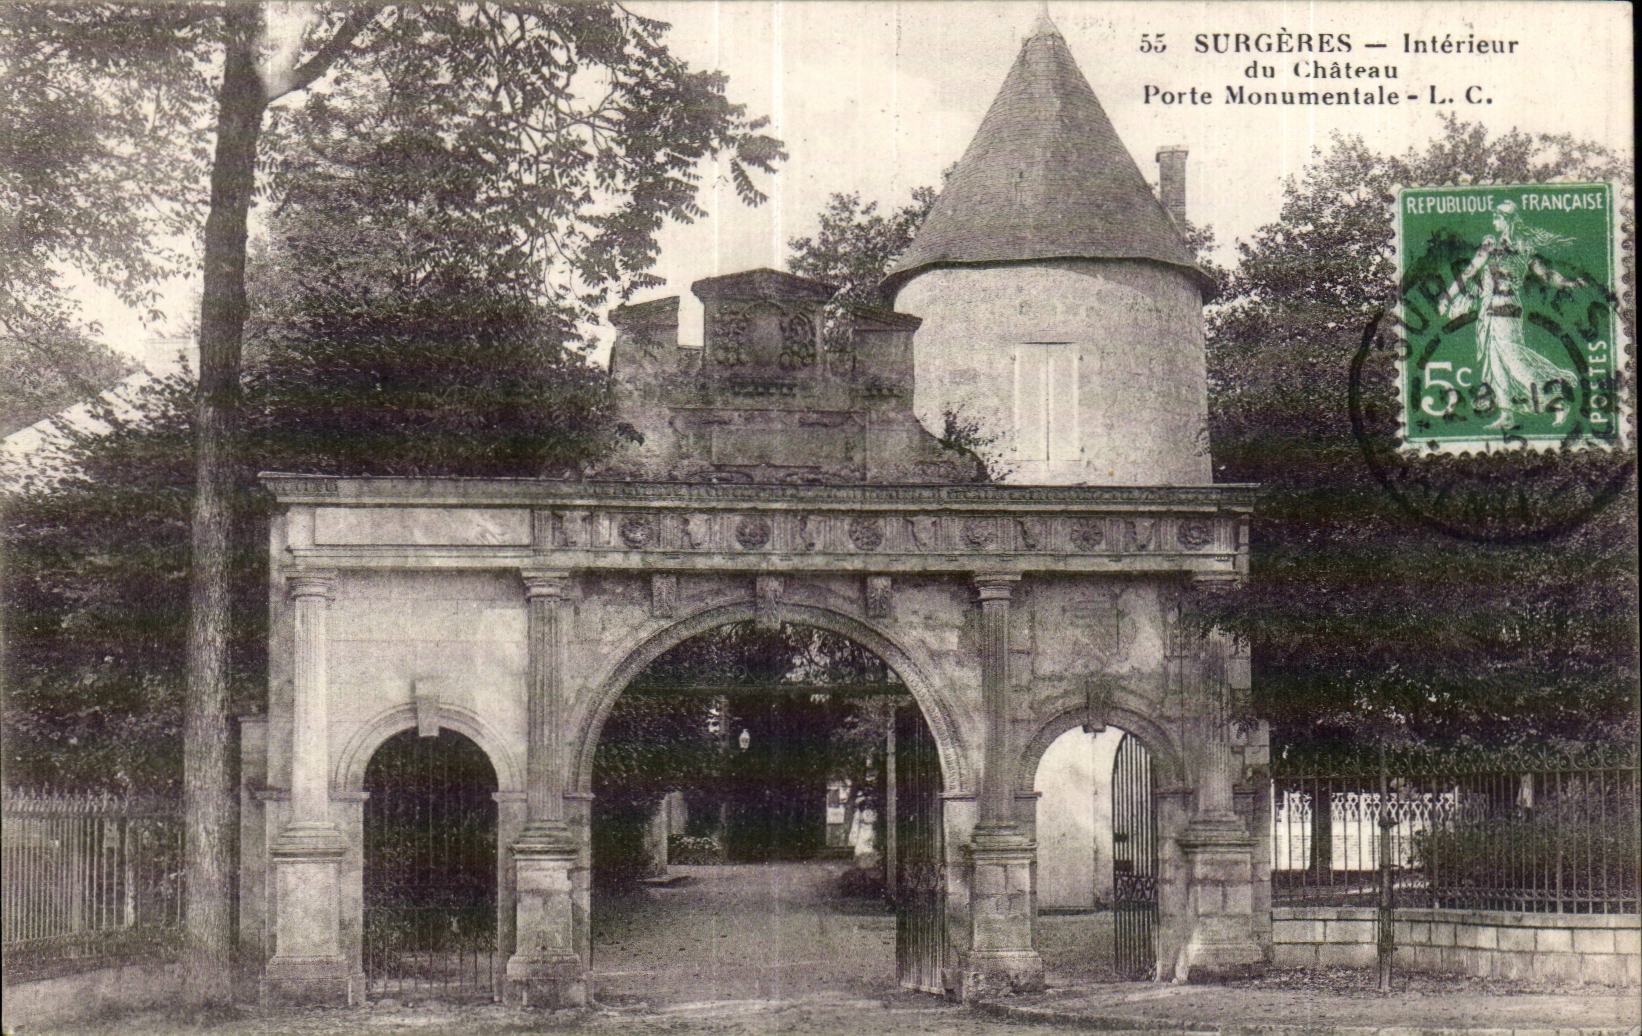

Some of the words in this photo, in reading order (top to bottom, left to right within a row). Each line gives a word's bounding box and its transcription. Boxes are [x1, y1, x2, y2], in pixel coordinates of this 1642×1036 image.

[1406, 195, 1495, 216] REPUBLIQUE
[1521, 192, 1604, 213] FRANÇAISE
[1588, 340, 1609, 425] POSTES
